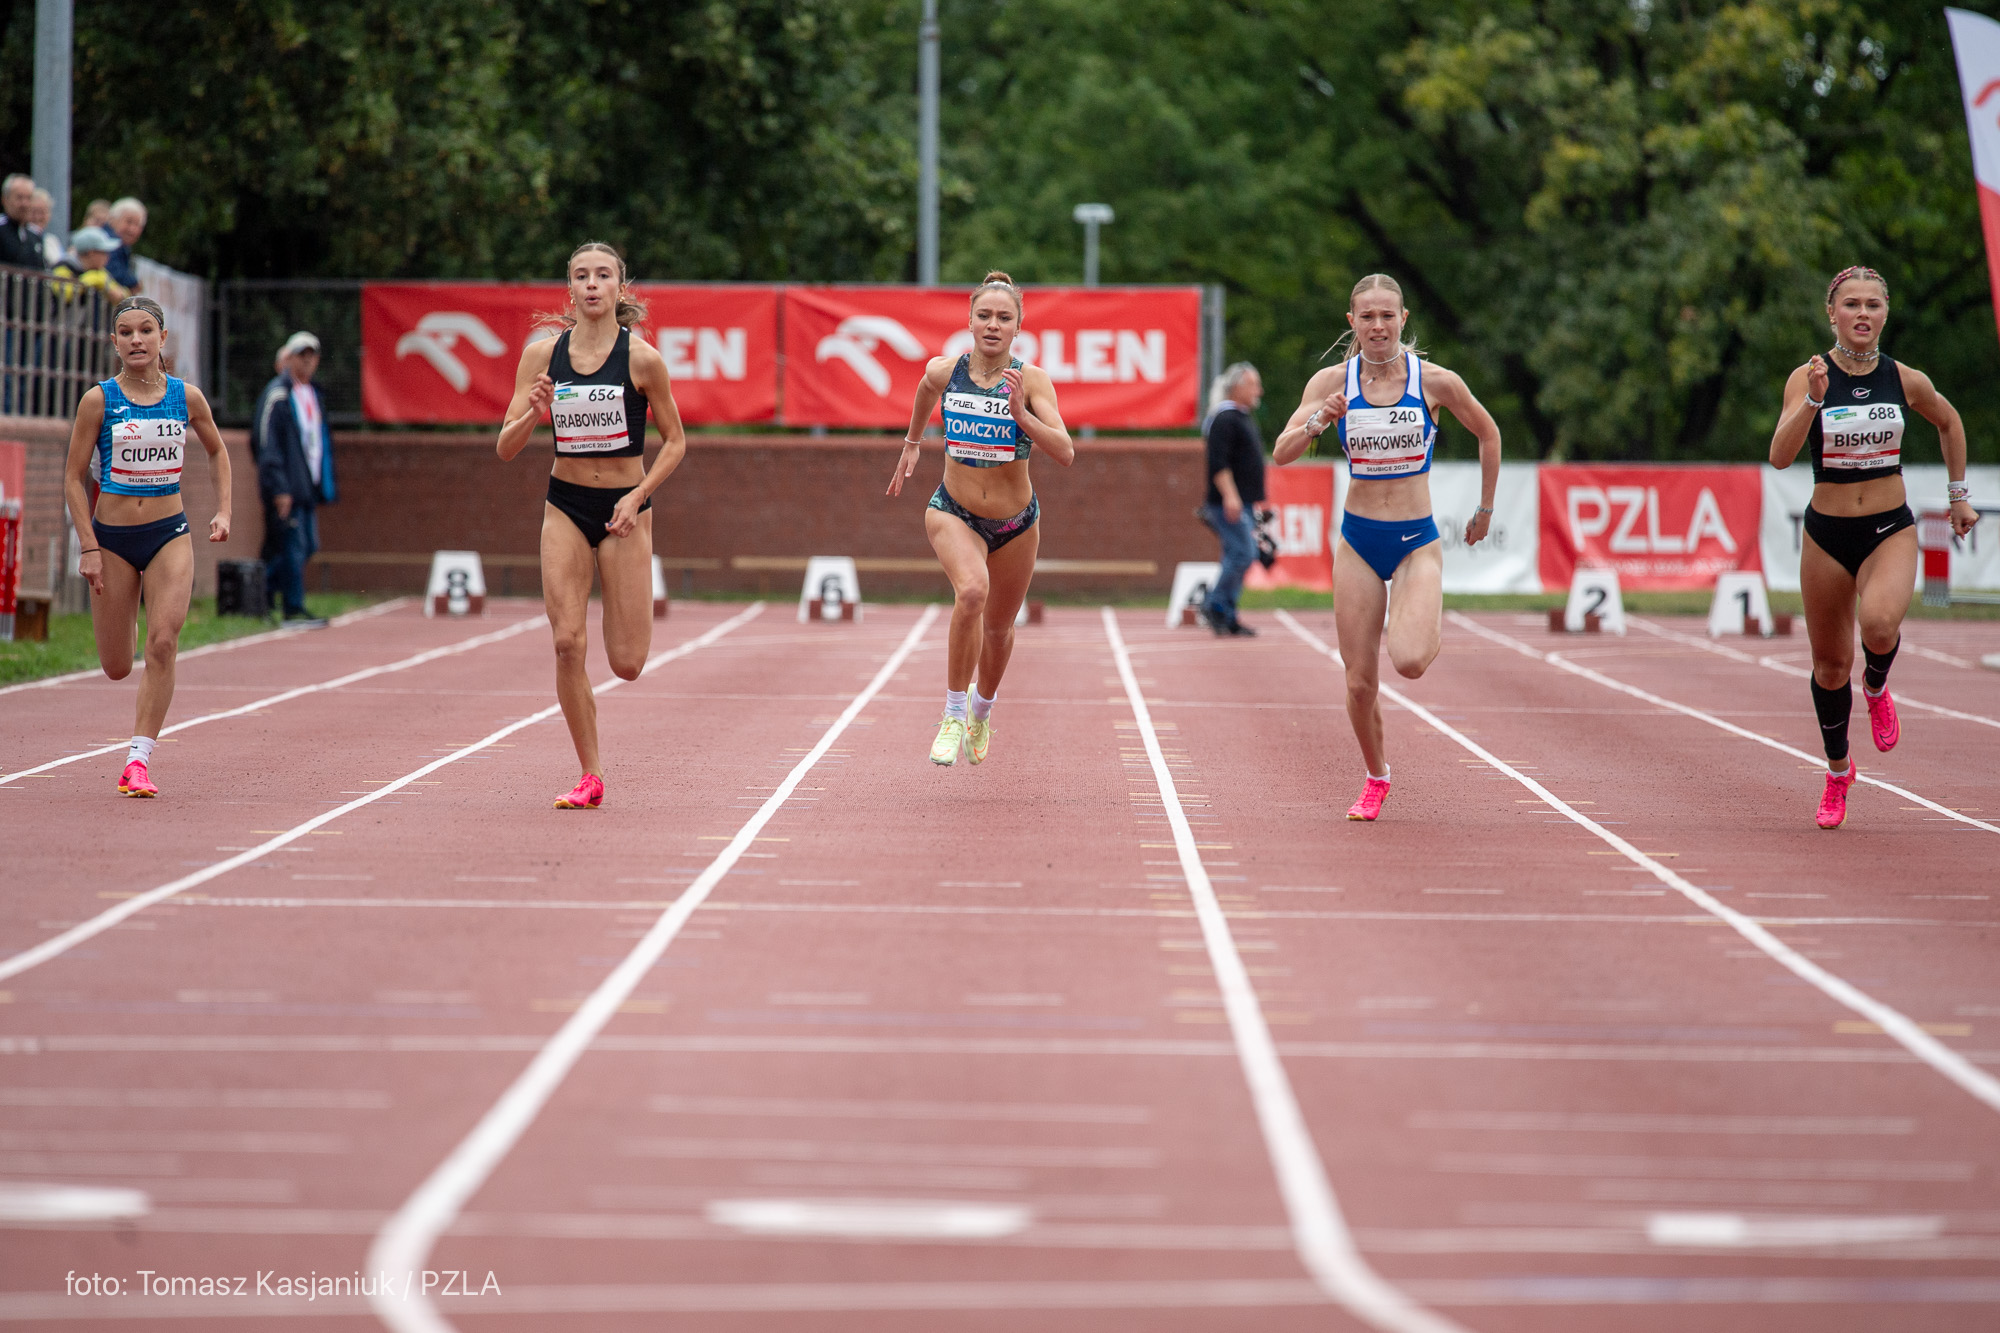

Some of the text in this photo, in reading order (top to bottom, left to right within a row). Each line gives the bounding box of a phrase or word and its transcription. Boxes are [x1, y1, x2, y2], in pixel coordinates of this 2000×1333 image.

[588, 389, 616, 402] 656
[953, 399, 976, 409] FUEL
[983, 400, 1010, 416] 316
[555, 410, 623, 428] GRABOWSKA
[1389, 410, 1417, 424] 240
[1868, 407, 1896, 420] 688
[156, 423, 182, 437] 113
[946, 417, 1012, 439] TOMCZYK
[1349, 432, 1422, 453] PIĄTKOWSKA
[1834, 431, 1894, 447] BISKUP
[121, 446, 178, 462] CIUPAK
[1566, 486, 1738, 554] PZLA
[820, 574, 843, 605] 6
[1583, 586, 1607, 619] 2
[1734, 590, 1749, 617] 1
